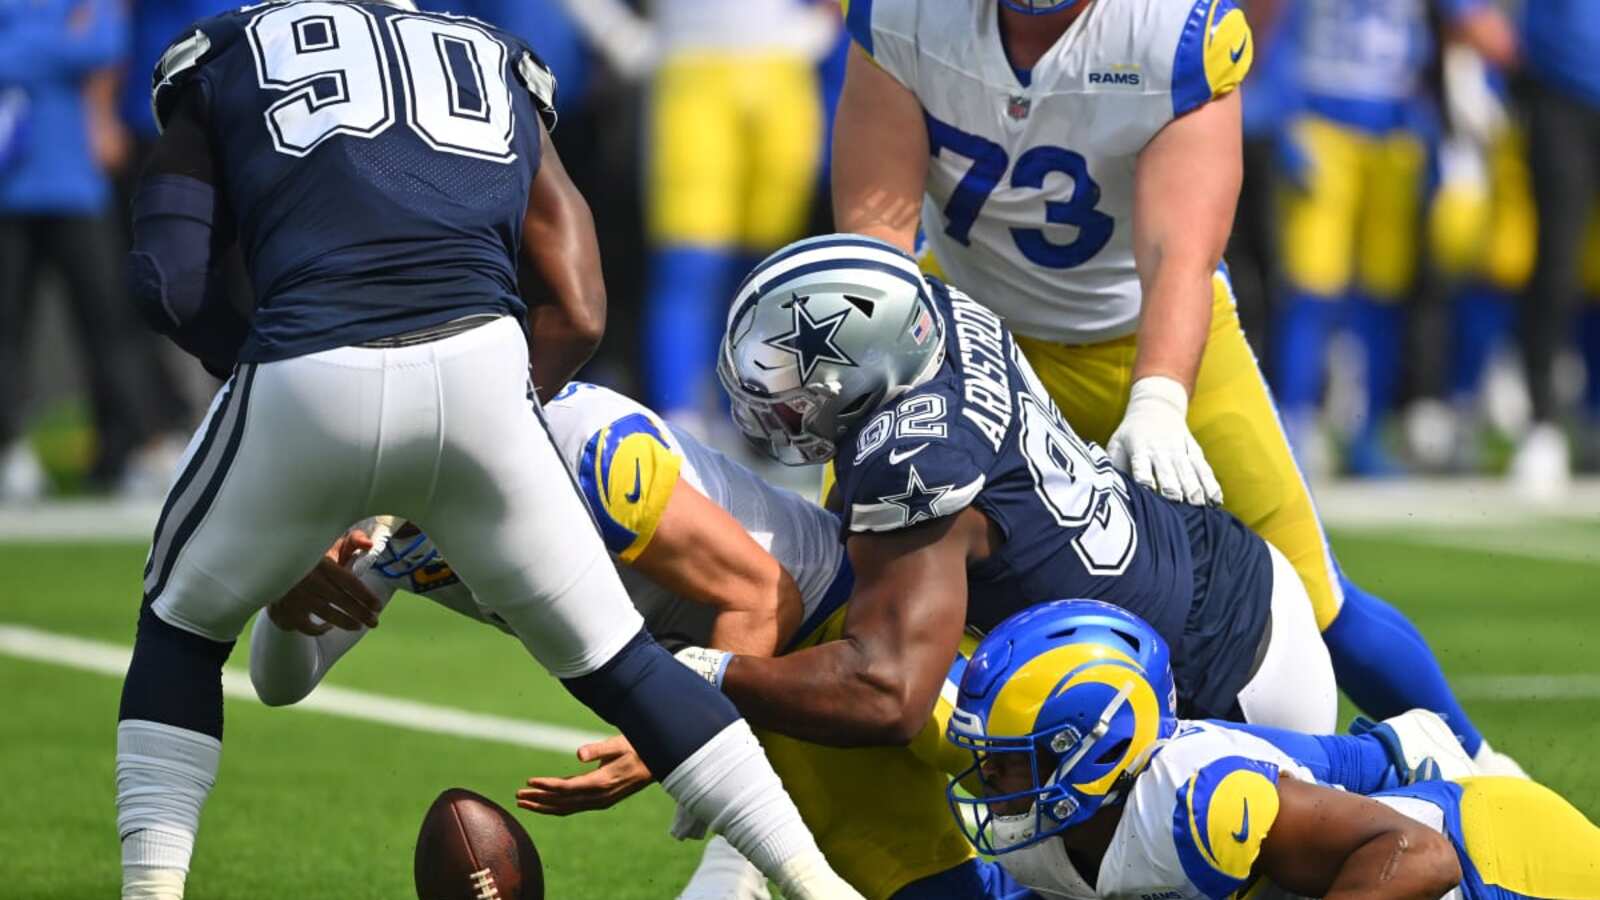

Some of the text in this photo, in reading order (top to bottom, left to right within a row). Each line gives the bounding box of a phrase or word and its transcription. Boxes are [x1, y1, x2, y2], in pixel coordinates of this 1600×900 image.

[245, 0, 517, 164] 90
[1089, 72, 1140, 85] RAMS
[922, 106, 1115, 269] 73
[853, 393, 949, 466] 92
[945, 284, 1013, 453] ARMSTRON
